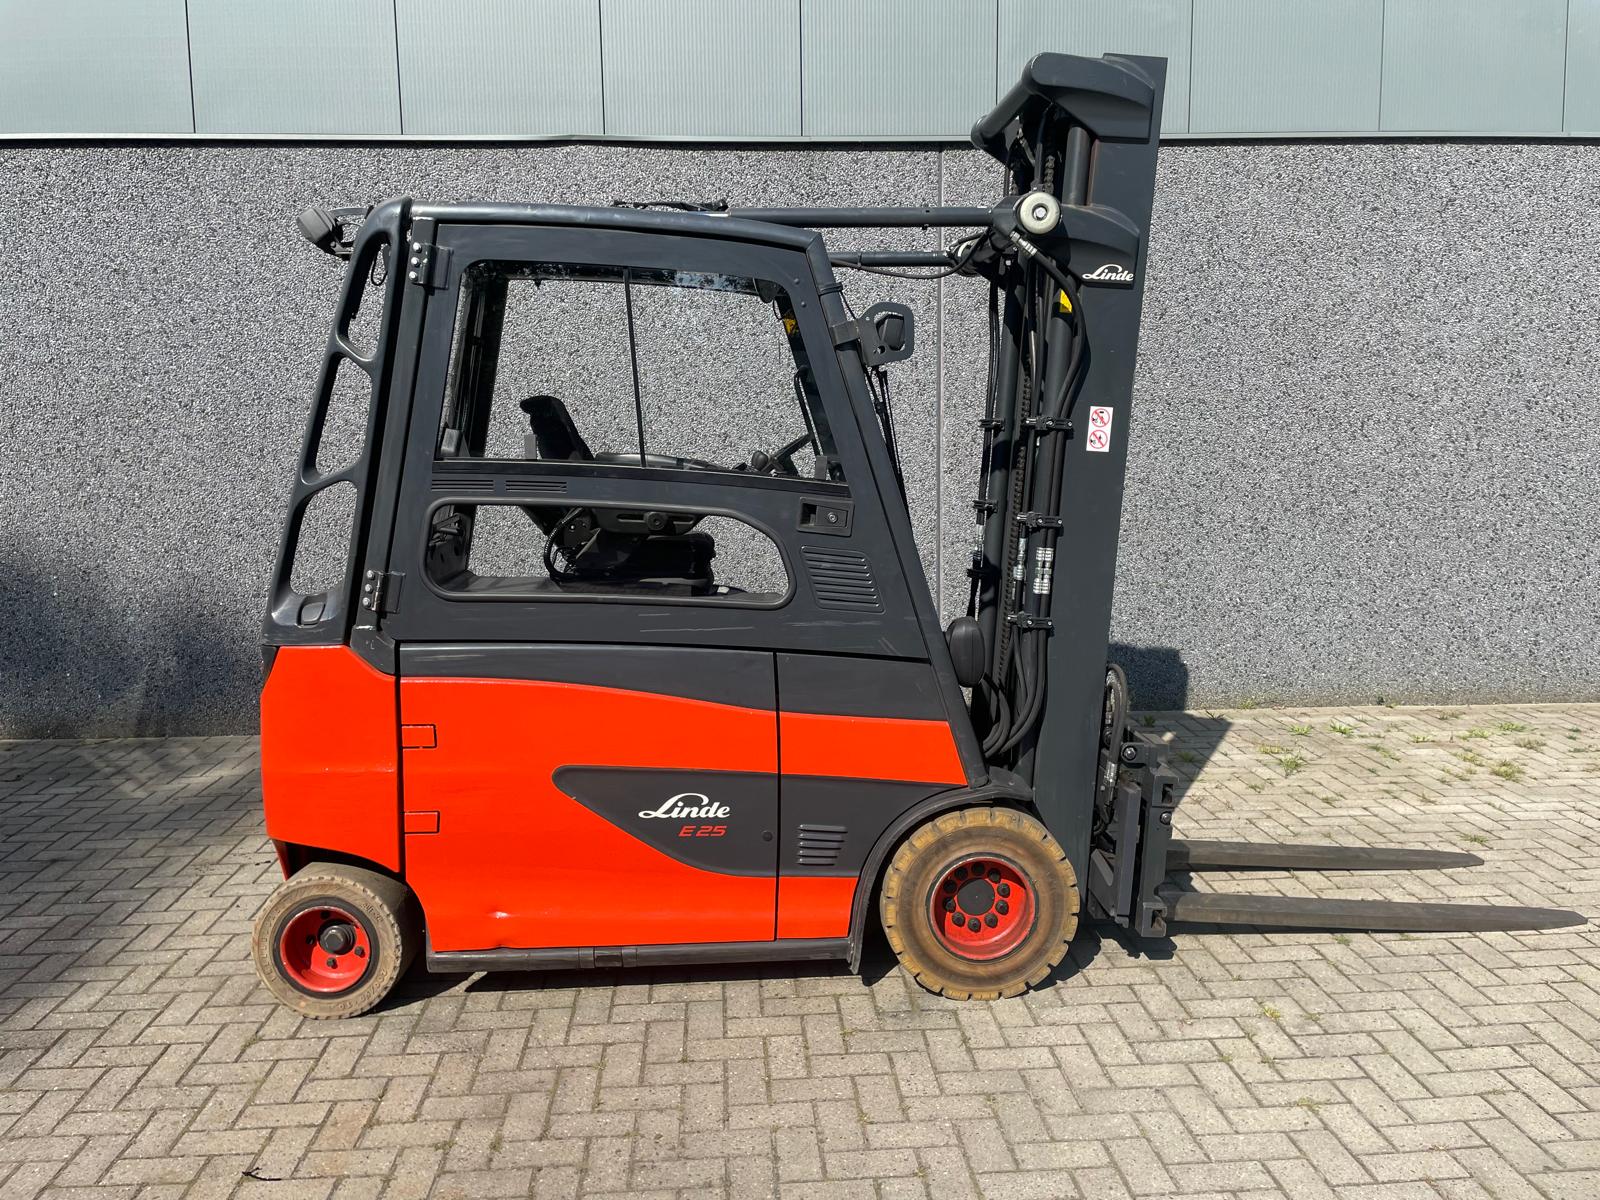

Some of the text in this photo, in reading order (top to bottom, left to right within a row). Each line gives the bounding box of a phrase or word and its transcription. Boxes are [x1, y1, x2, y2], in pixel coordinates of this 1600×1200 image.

[1082, 263, 1134, 281] Linde
[638, 792, 730, 819] Linde
[678, 825, 727, 837] E 25
